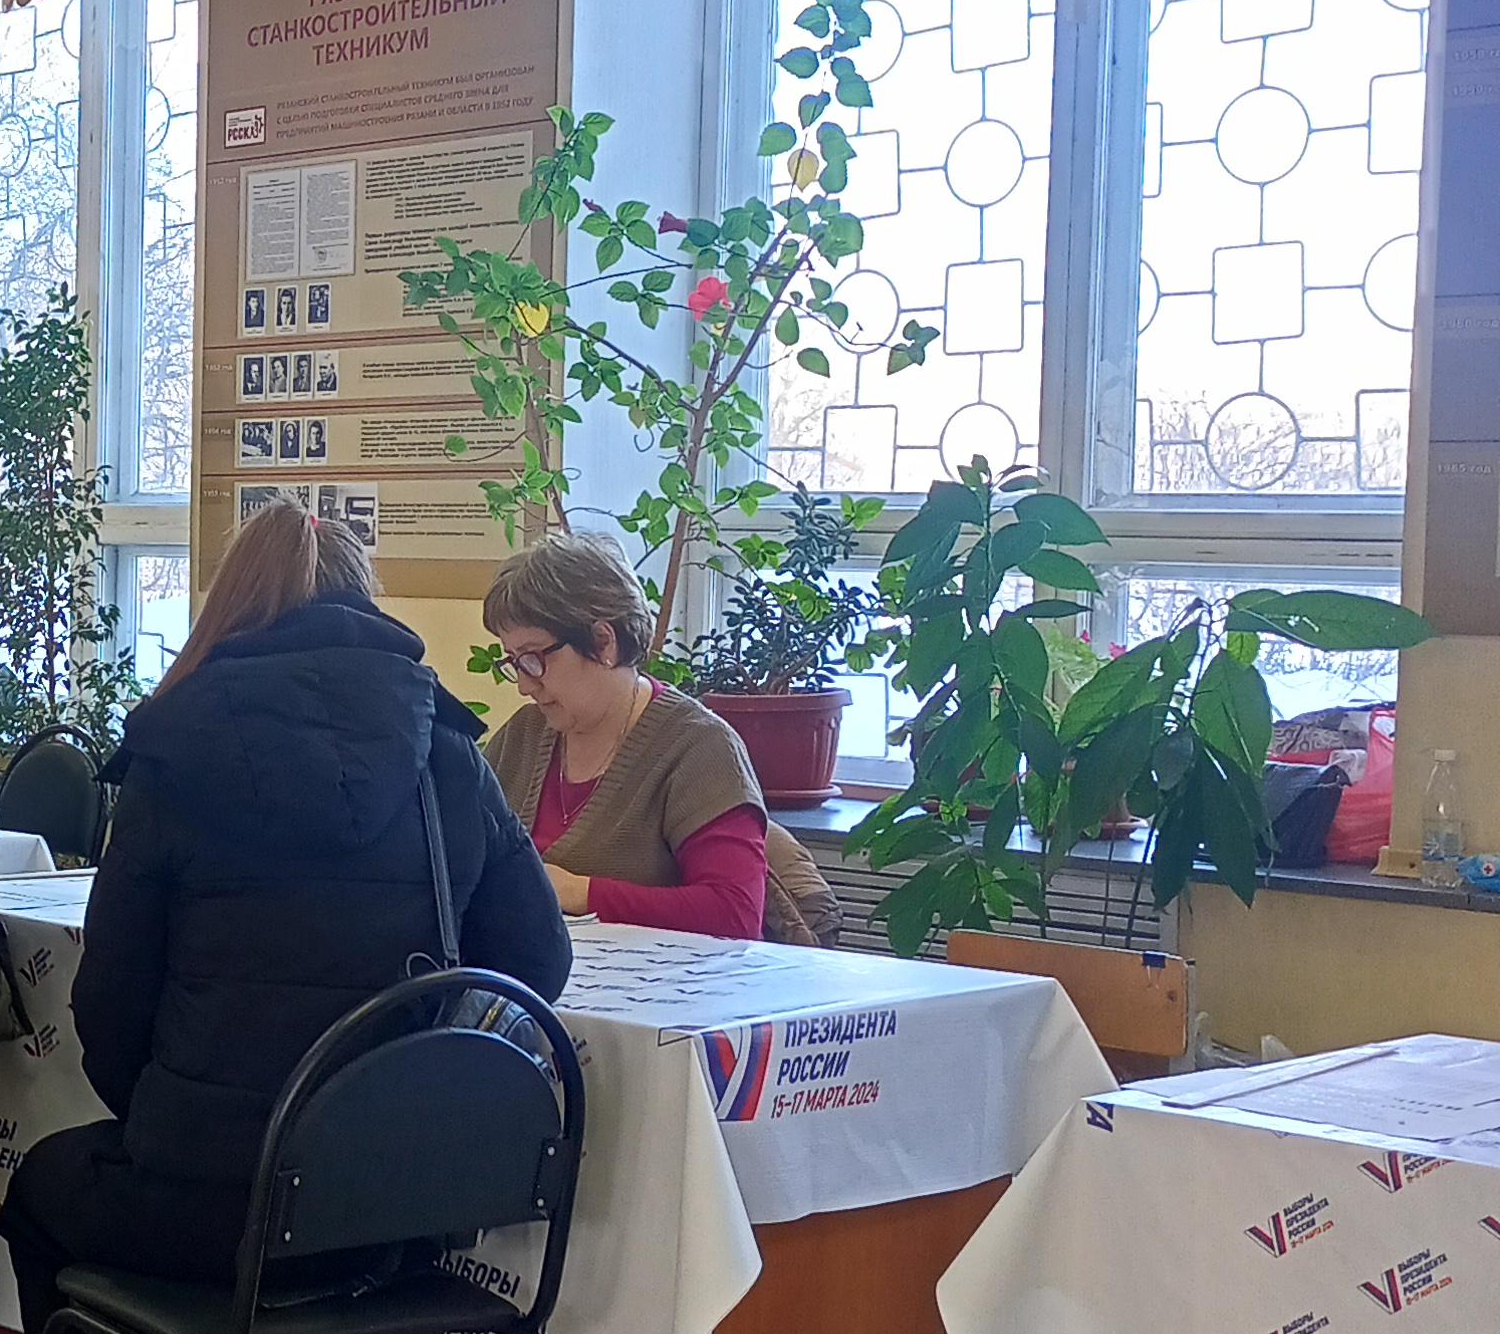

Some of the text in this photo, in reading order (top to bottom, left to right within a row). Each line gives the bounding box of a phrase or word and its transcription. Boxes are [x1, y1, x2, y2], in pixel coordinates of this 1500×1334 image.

[312, 27, 429, 66] ТЕХНИКУМ
[784, 1009, 897, 1048] ПРЕЗИДЕНТА
[776, 1050, 850, 1086] РОССИИ
[803, 1084, 849, 1114] МАРТА
[847, 1079, 880, 1107] 2024
